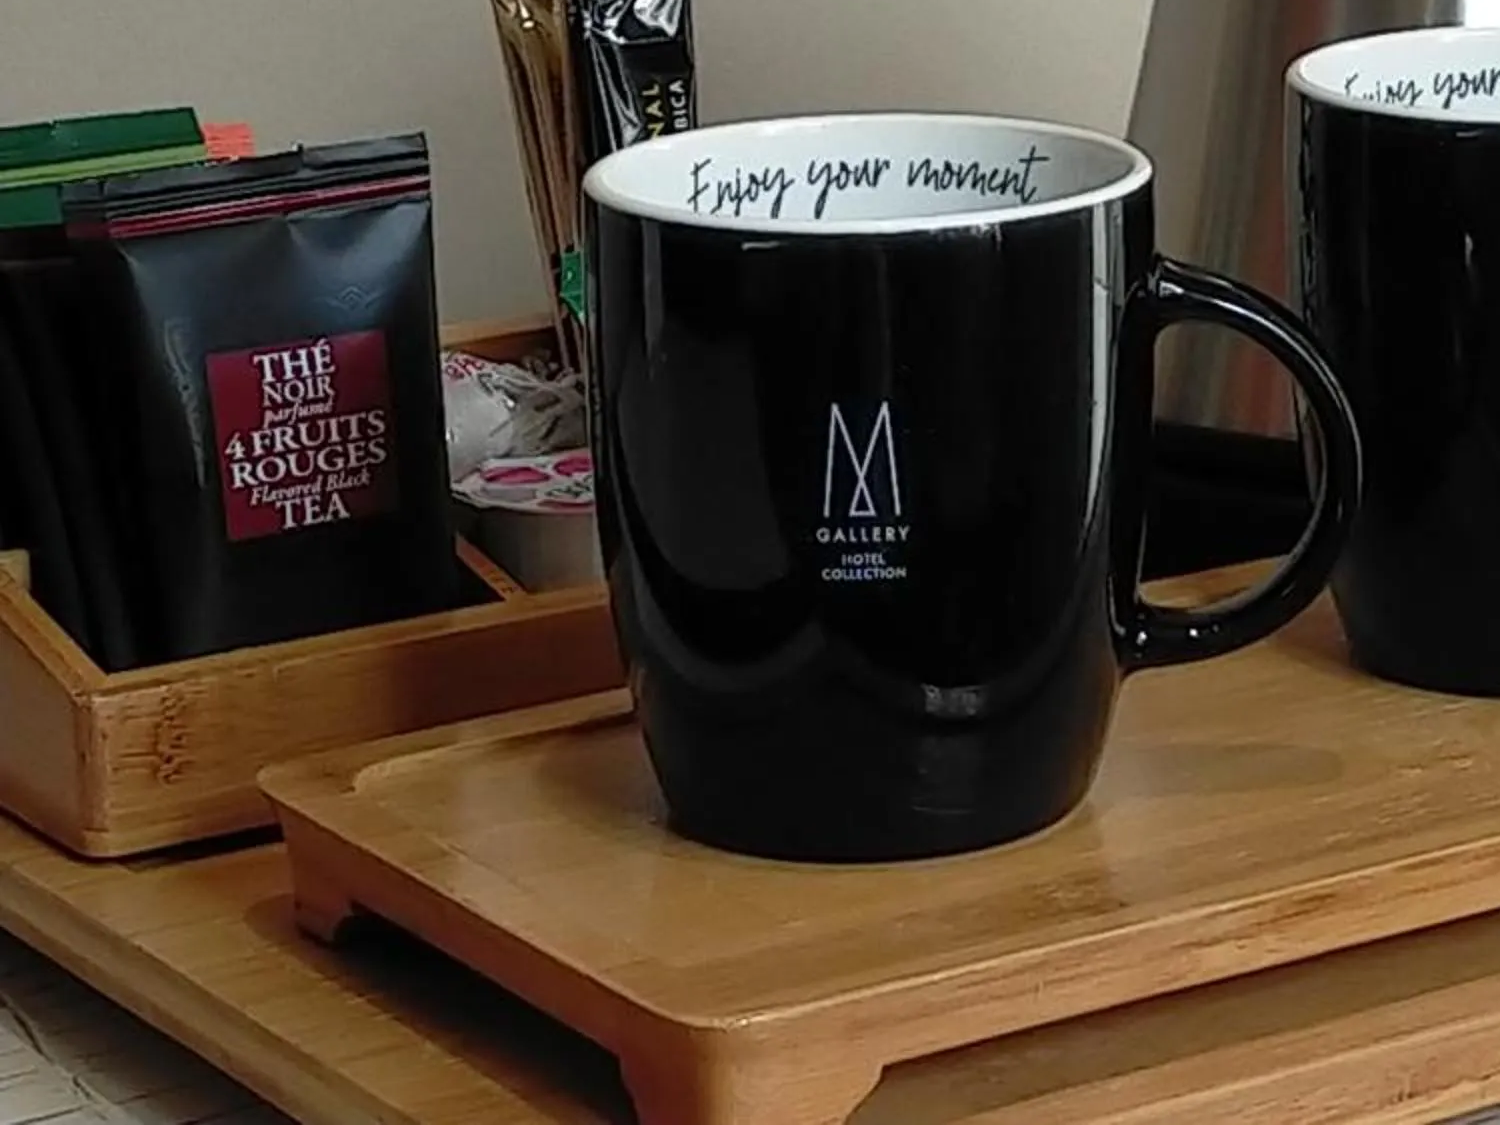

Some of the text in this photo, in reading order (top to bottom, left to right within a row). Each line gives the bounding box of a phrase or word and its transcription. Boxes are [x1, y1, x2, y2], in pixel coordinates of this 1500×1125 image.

[687, 146, 1051, 220] Enjoy your moment
[252, 337, 336, 384] THÉ
[262, 376, 335, 408] NOIR
[225, 409, 386, 461] 4 FRUITS
[229, 437, 388, 490] ROUGES
[250, 474, 323, 507] Flavored
[275, 492, 351, 530] TEA
[815, 525, 912, 545] GALLERY
[820, 566, 908, 581] COLLECTION
[841, 553, 887, 567] HOTEL
